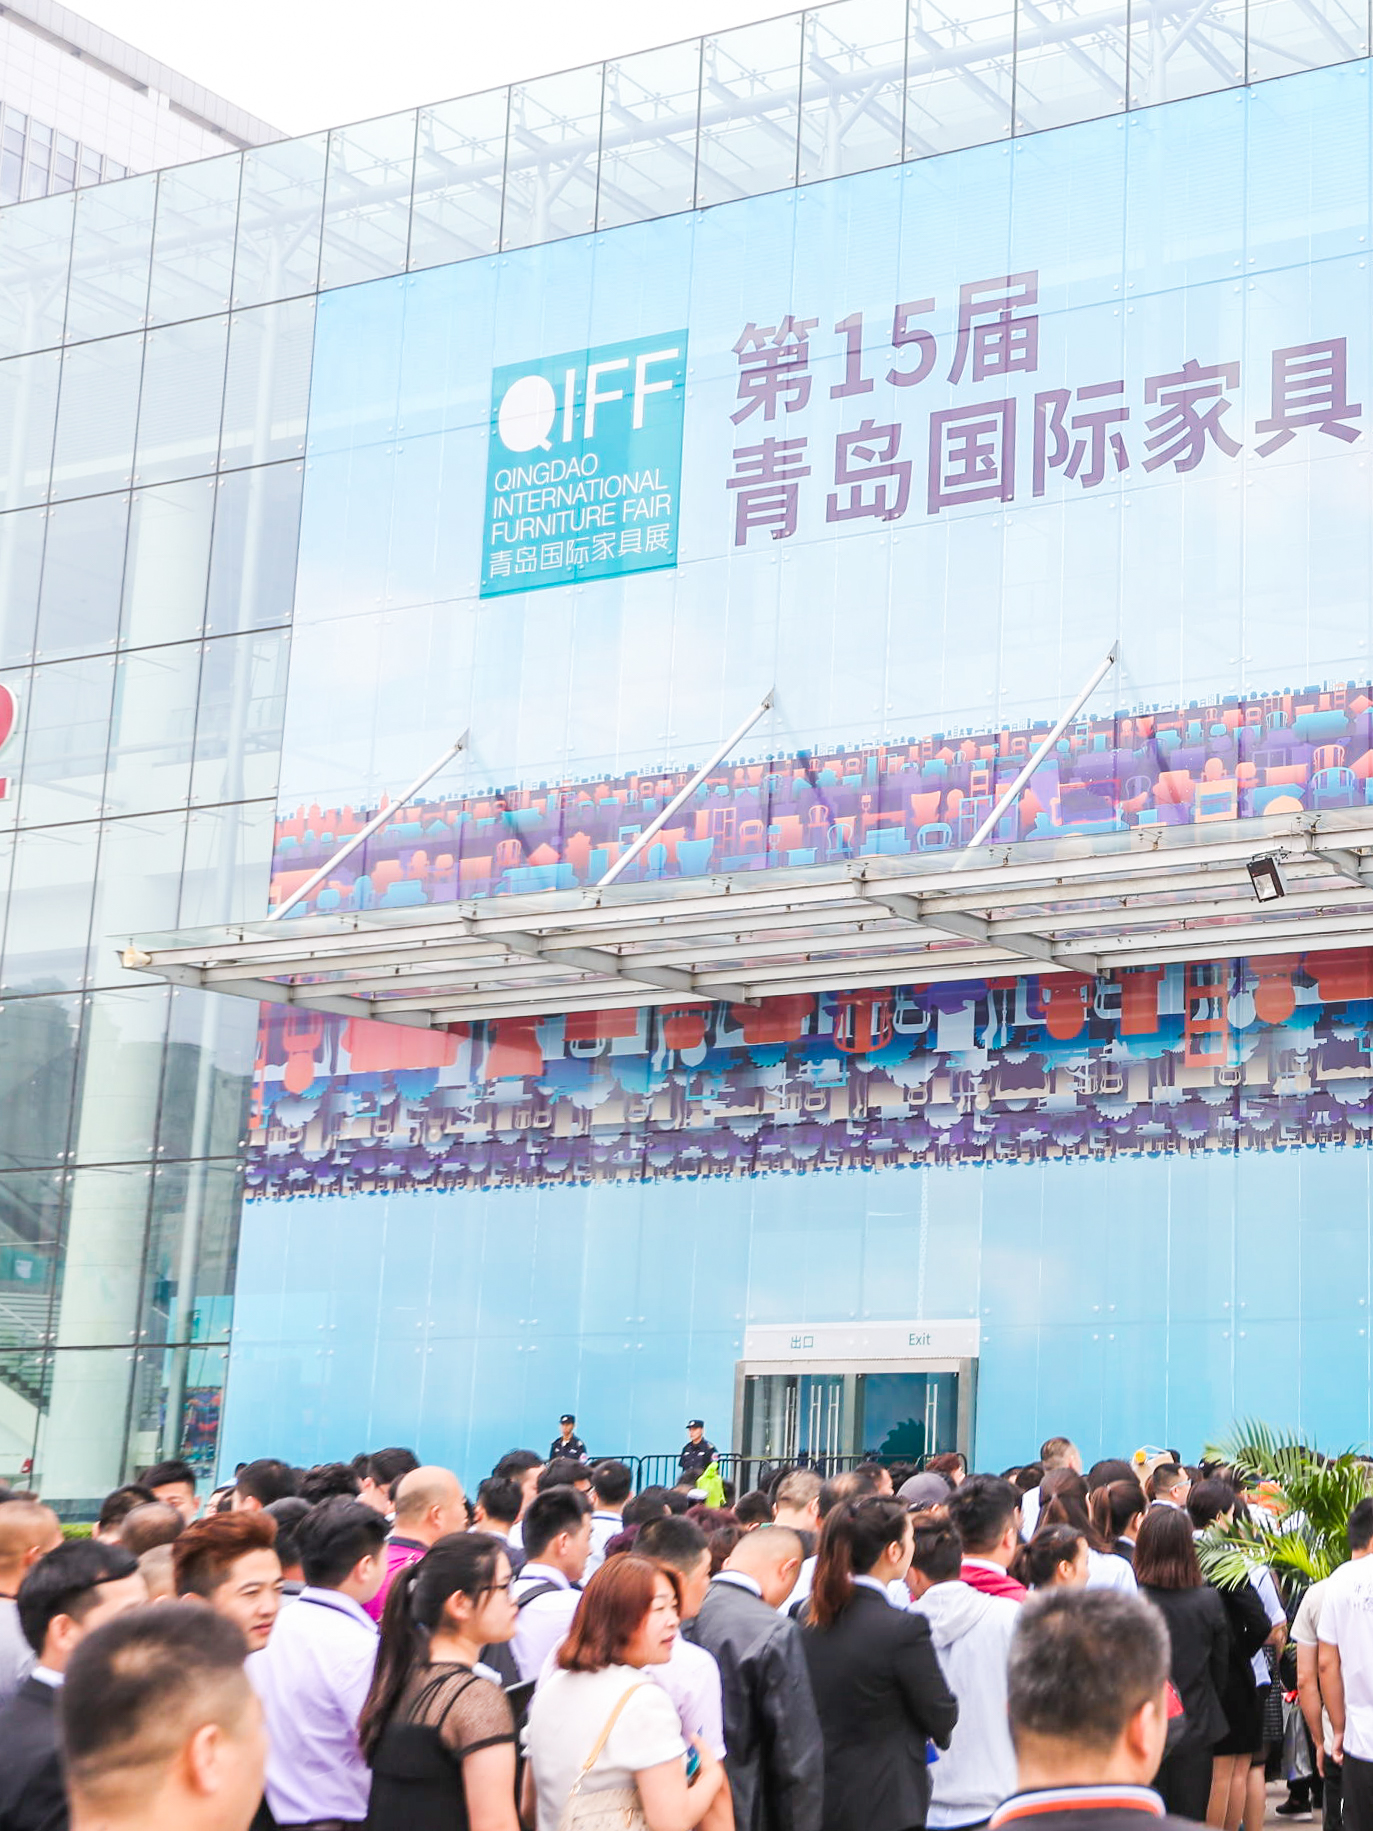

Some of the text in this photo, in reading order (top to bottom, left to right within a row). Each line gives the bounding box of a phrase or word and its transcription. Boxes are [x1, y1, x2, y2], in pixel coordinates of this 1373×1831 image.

[729, 270, 1038, 425] 第15届
[499, 348, 679, 452] QIFF
[493, 468, 668, 519] INTERNATIONAL
[494, 453, 598, 491] QINGDAO
[491, 493, 671, 545] FURNITURE FAIR
[489, 523, 670, 578] 青岛国际家具展
[790, 1335, 814, 1349] 出口
[908, 1332, 931, 1346] Exit
